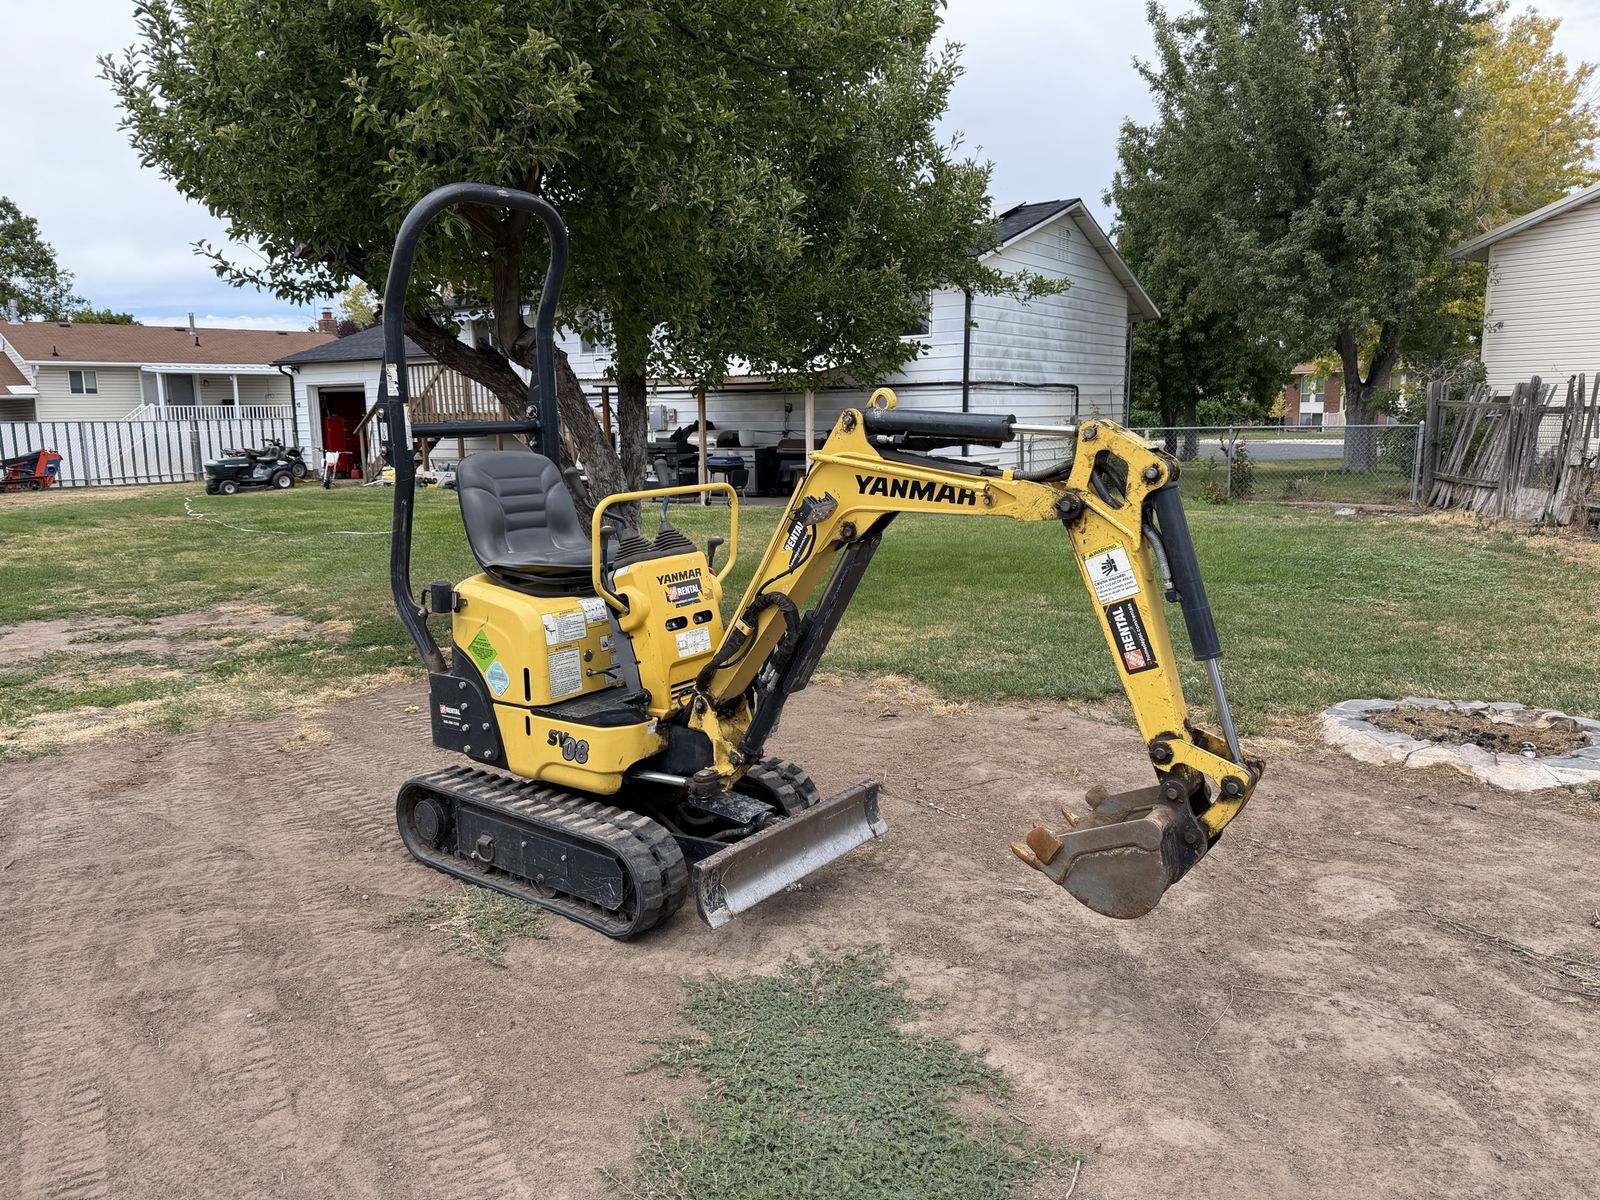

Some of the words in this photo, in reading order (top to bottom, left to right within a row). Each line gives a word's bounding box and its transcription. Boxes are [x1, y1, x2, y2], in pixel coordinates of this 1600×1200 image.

[855, 474, 977, 506] YANMAR
[656, 567, 702, 585] YANMAR
[677, 583, 700, 597] RENTAL
[1112, 606, 1137, 652] RENTAL
